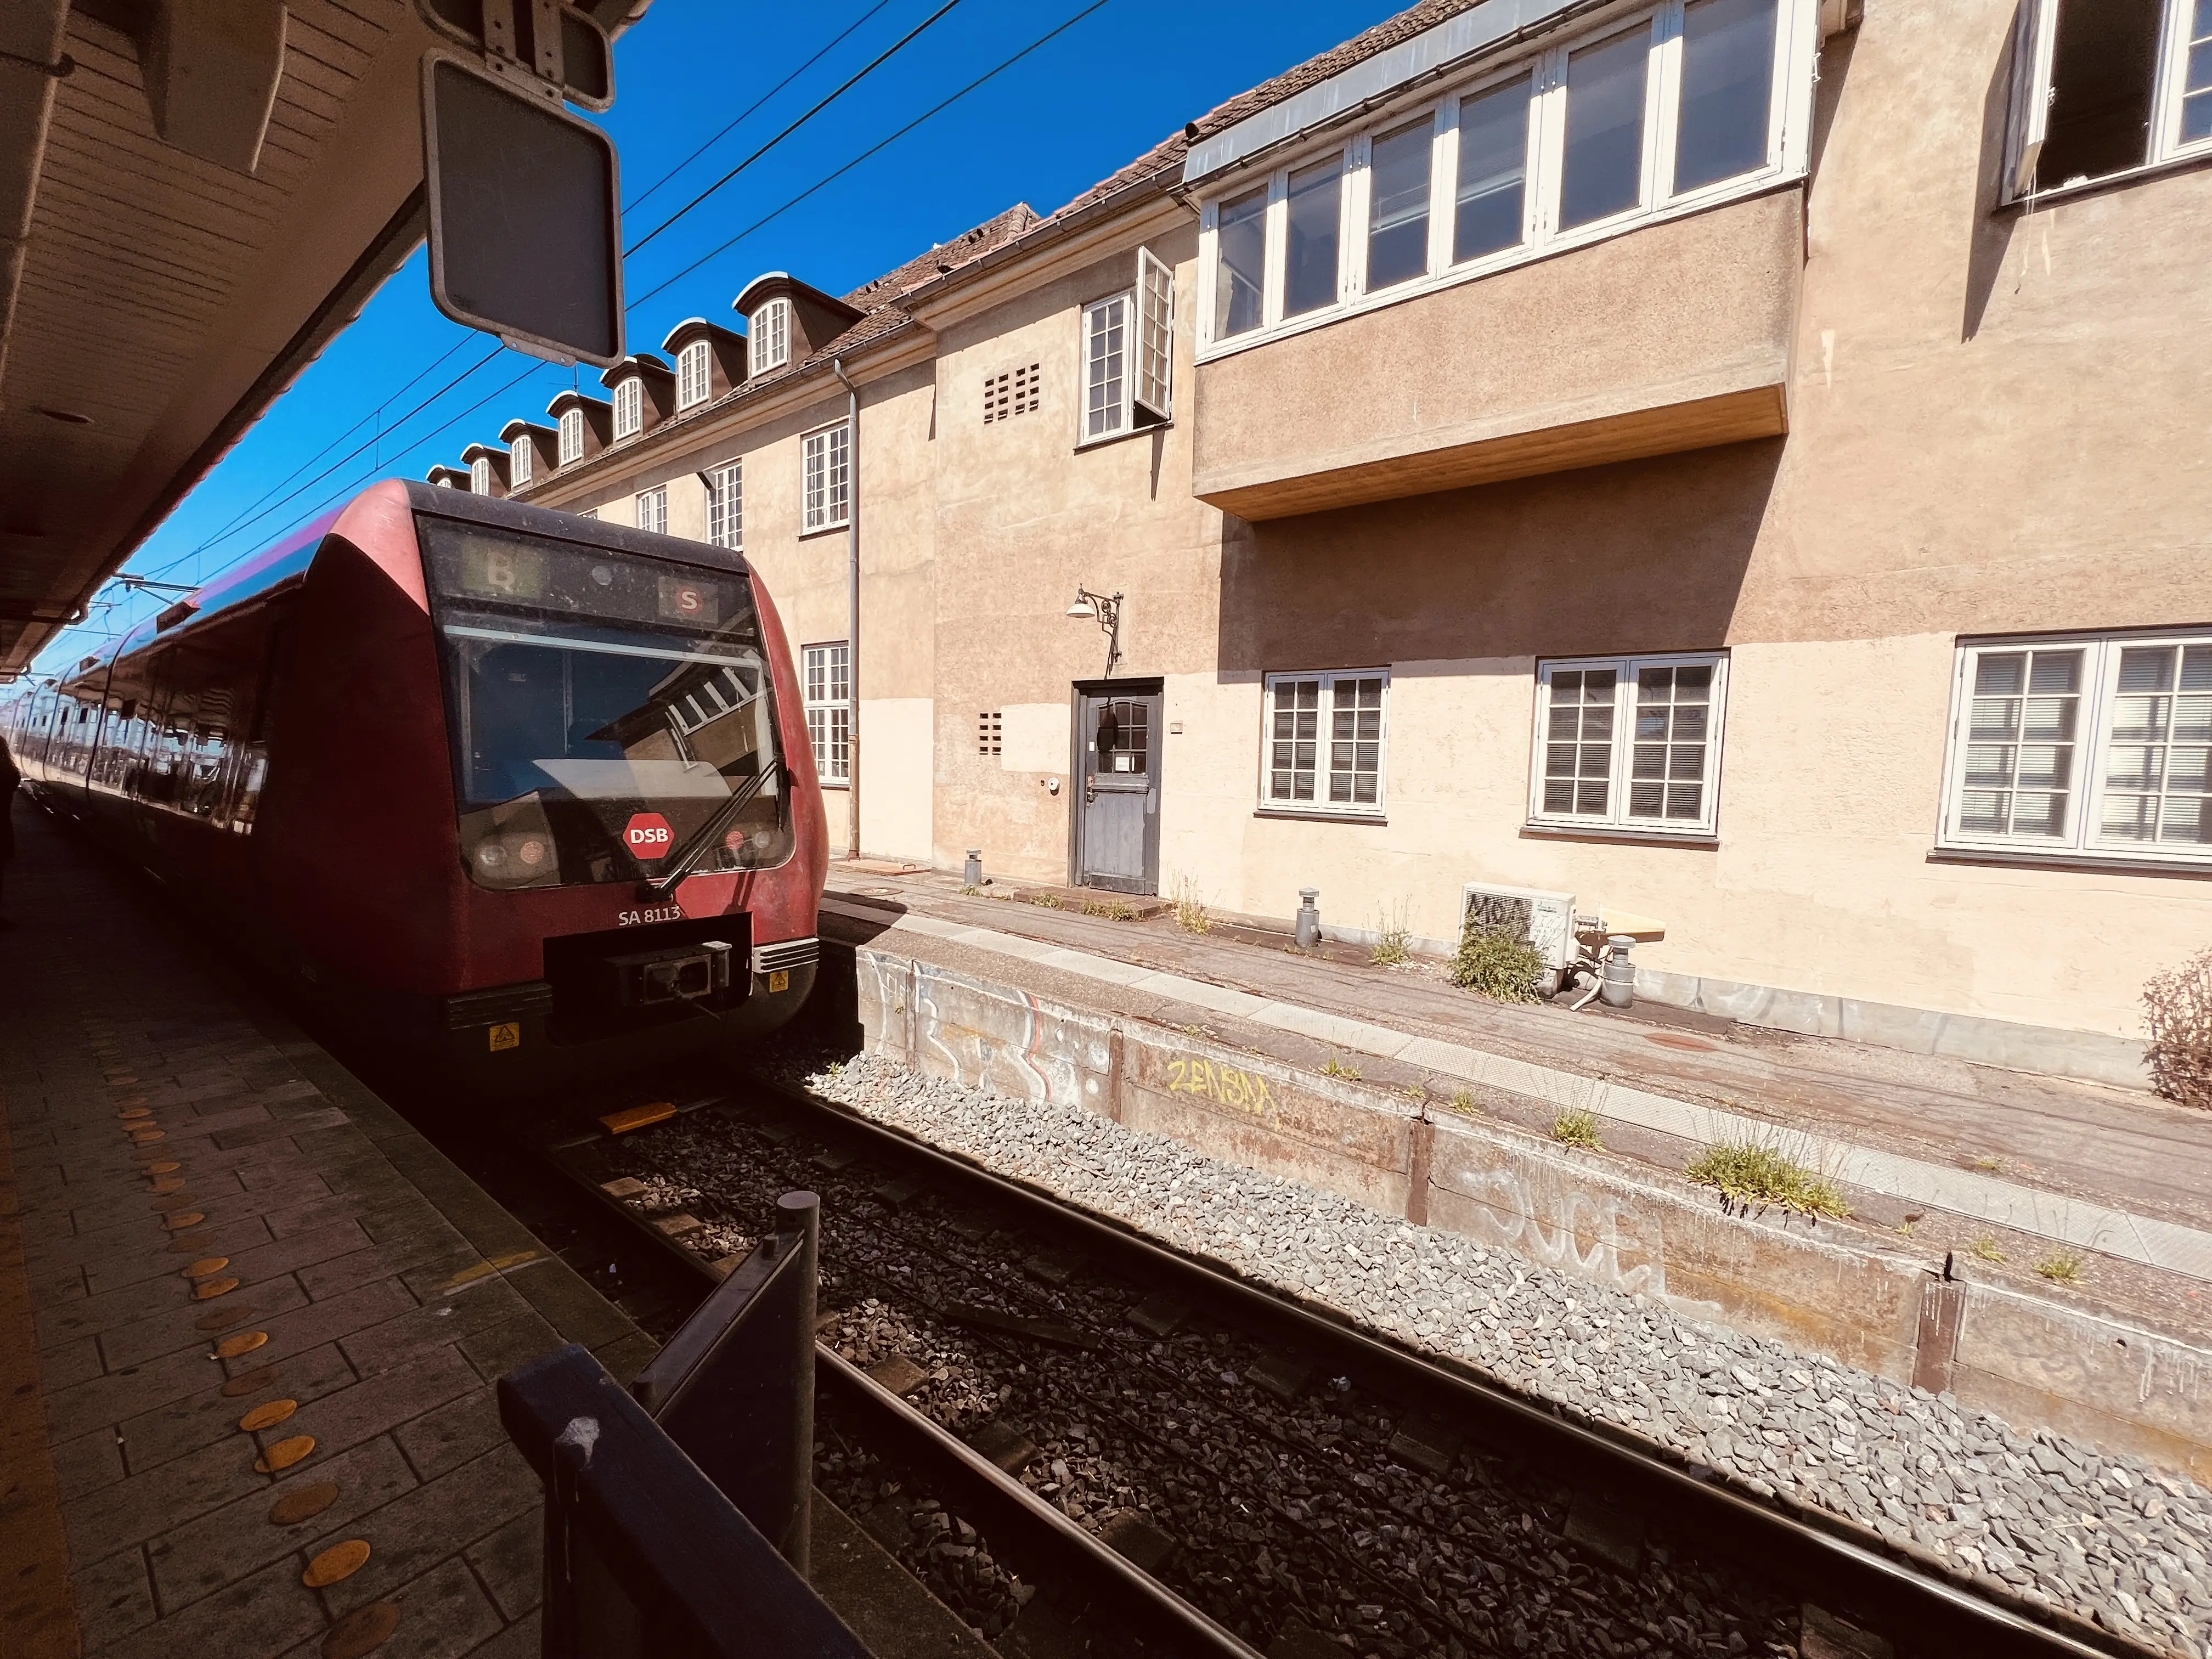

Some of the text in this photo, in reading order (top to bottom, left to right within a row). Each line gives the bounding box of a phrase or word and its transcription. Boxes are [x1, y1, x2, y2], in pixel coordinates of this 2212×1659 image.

[488, 550, 515, 588] B
[682, 591, 697, 610] S
[630, 827, 669, 844] DSB
[618, 905, 681, 926] SA 8113
